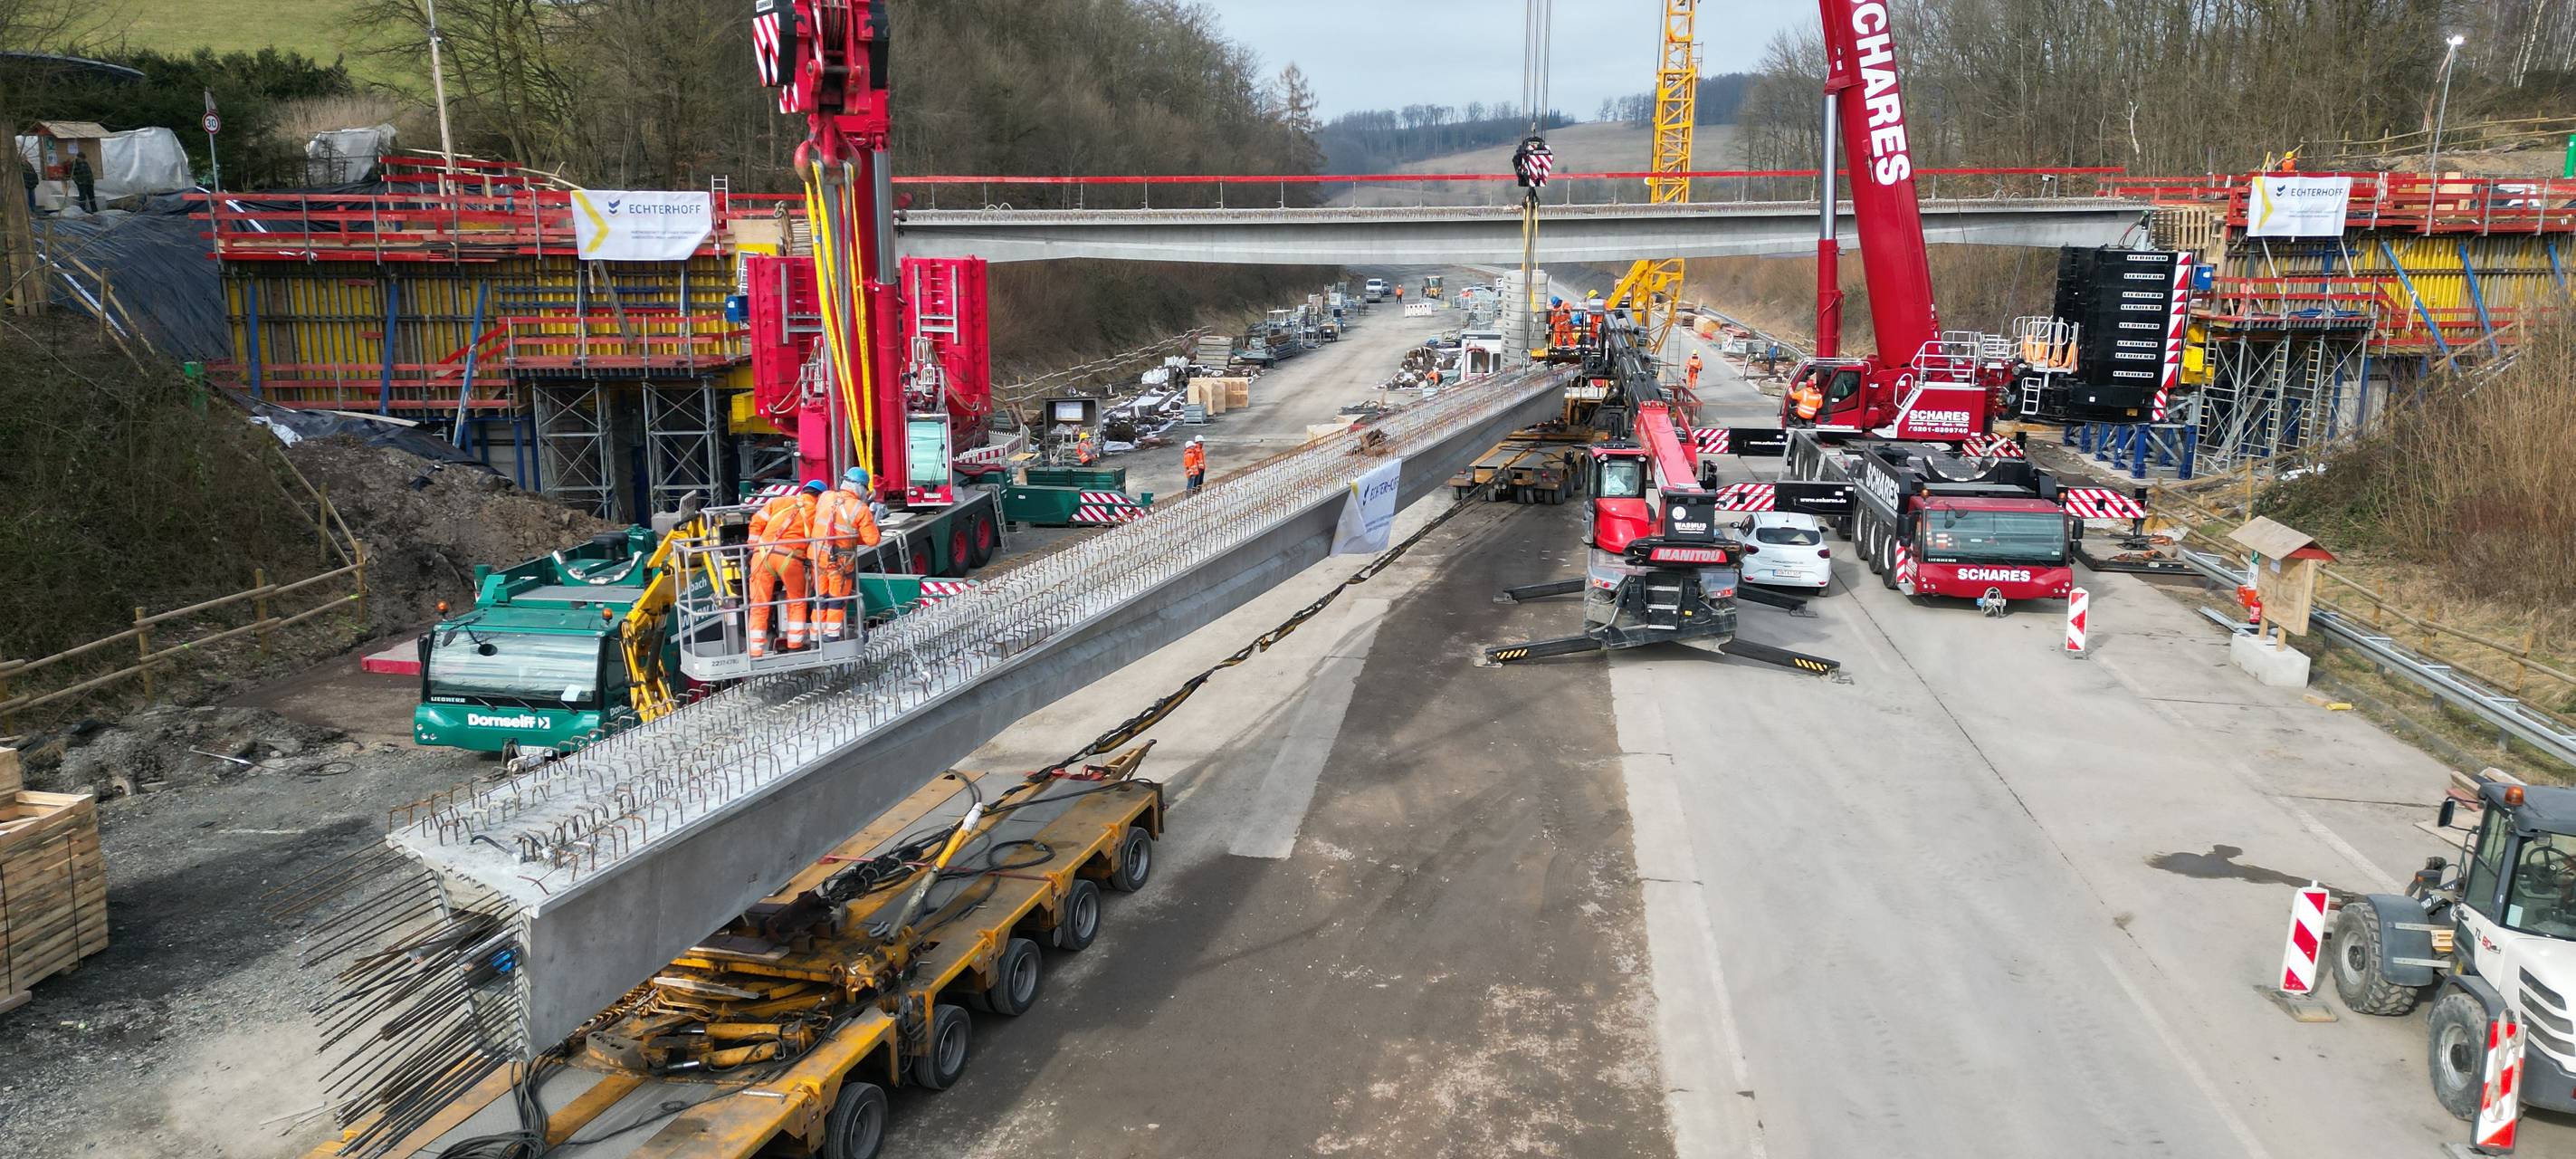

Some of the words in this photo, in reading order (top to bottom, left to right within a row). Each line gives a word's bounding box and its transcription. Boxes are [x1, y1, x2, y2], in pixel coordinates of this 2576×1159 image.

[1852, 0, 1911, 186] CHARES
[206, 119, 217, 128] 30
[2291, 187, 2343, 196] ECHTERHOFF
[629, 204, 701, 214] ECHTERHOFF
[1909, 410, 1970, 421] SCHARES
[1865, 461, 1900, 511] SCHARES
[1657, 549, 1721, 561] MANITOU
[1958, 568, 2031, 581] SCHARES
[468, 714, 536, 728] Dornseiff
